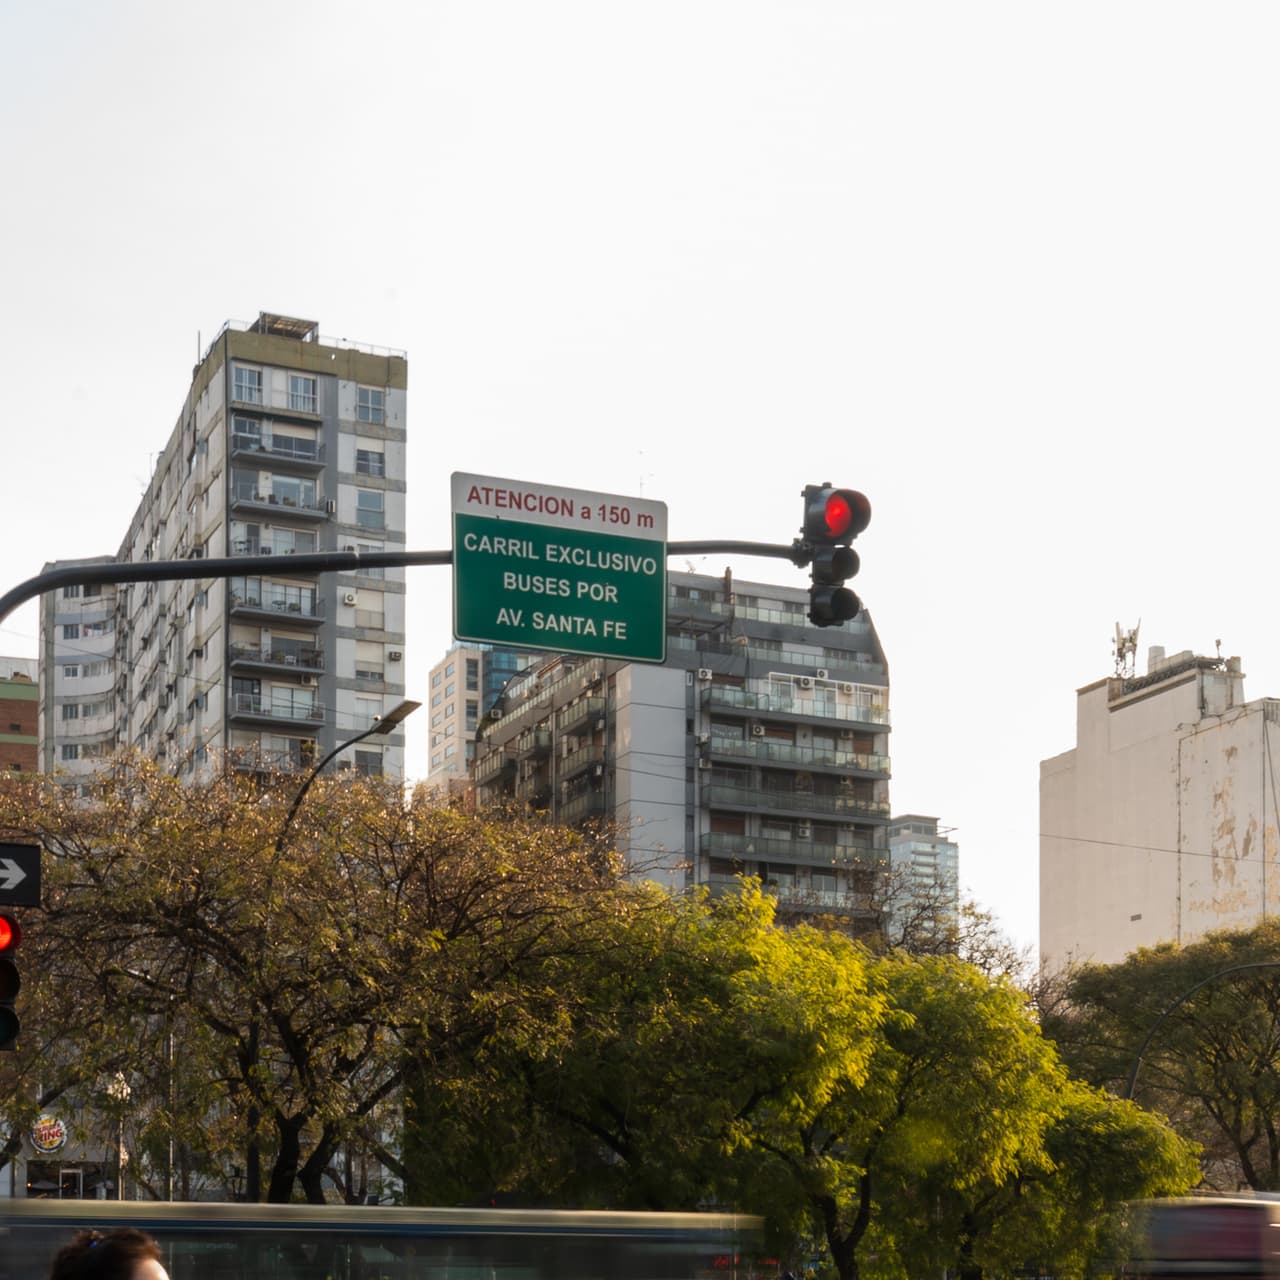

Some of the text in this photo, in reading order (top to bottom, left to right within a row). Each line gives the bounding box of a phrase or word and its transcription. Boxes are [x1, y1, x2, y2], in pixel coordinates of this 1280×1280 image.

[467, 485, 654, 528] ATENCION a 150 m
[463, 533, 657, 575] CARRIL EXCLUSIVO
[503, 572, 619, 603] BUSES POR
[496, 608, 627, 640] AV. SANTA FE
